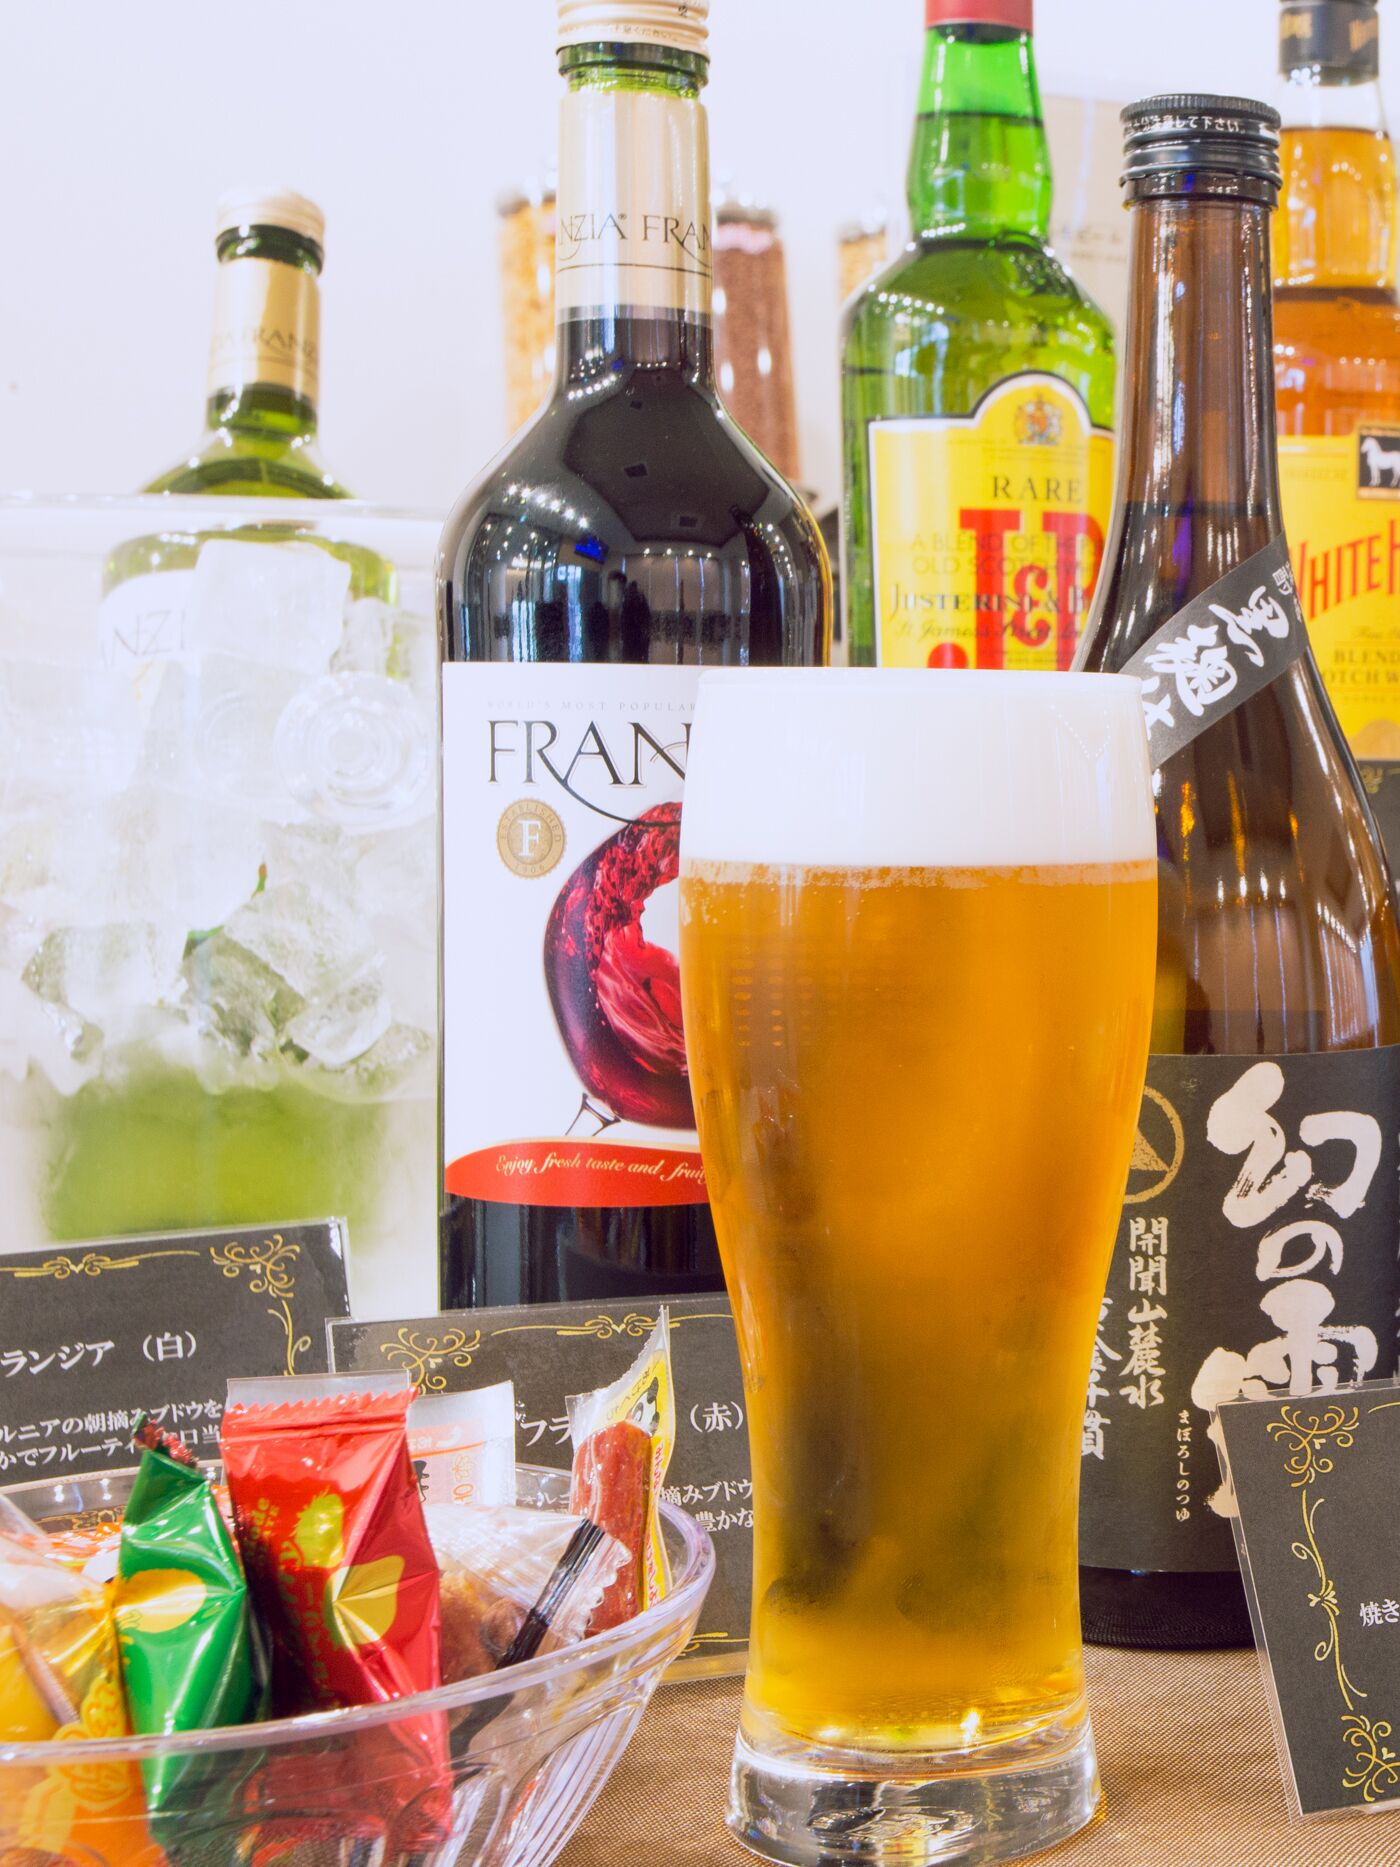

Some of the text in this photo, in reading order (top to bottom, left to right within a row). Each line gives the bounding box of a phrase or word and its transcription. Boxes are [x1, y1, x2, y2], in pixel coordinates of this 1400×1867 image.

[993, 475, 1082, 503] RARE
[560, 701, 606, 712] MOST
[517, 819, 543, 858] F
[496, 1154, 535, 1177] Enjoy
[533, 1152, 583, 1175] fresh
[585, 1157, 626, 1172] taste
[627, 1159, 664, 1176] and
[1117, 1216, 1169, 1410] 開聞山麓水
[1175, 1409, 1193, 1523] まぼろしのつゆ
